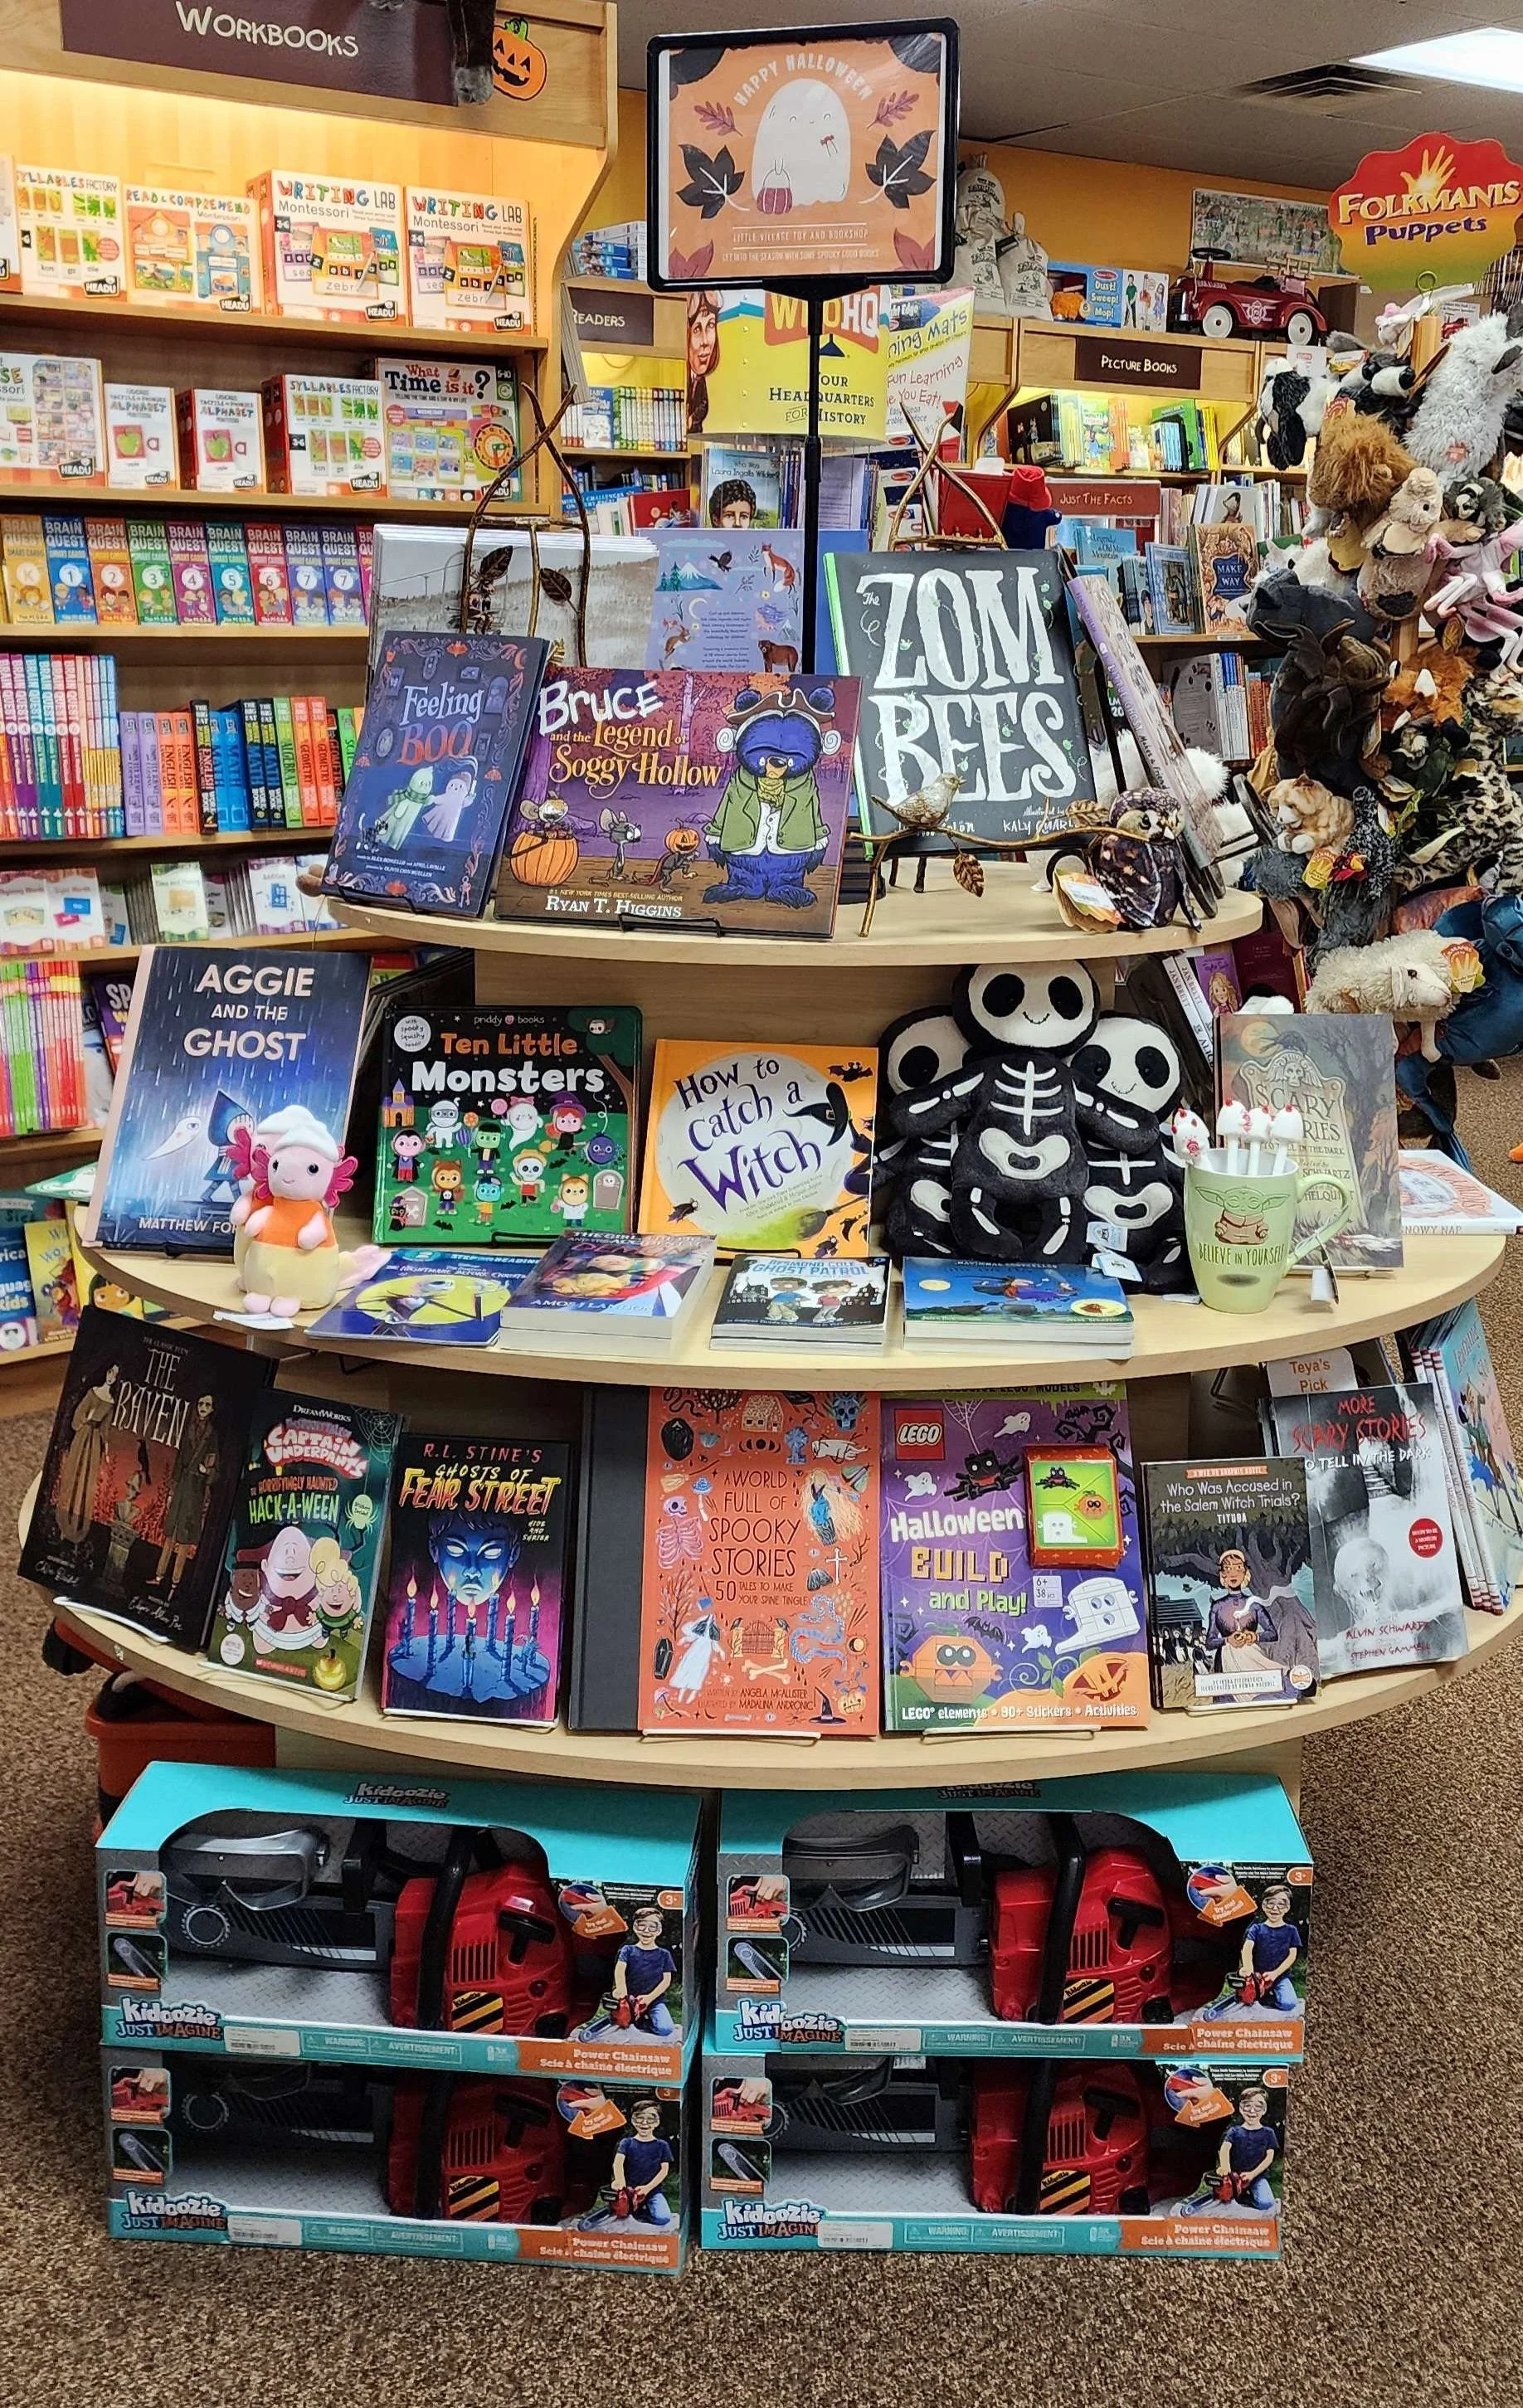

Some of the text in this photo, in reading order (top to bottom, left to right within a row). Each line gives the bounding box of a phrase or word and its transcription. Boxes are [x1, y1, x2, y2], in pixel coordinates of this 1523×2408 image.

[175, 1, 359, 58] WORKBOOKS
[733, 52, 873, 106] HAPPY HALLOWEEN
[126, 189, 158, 204] READ
[277, 180, 396, 210] WRITING LAB
[1338, 180, 1521, 225] FOLKMANIS
[279, 199, 350, 219] Montessori
[732, 228, 869, 243] LITTLE VILLAGE TOY AND BOOKSHOP
[1095, 280, 1117, 291] Dust!
[1091, 292, 1119, 306] Sweep!
[771, 293, 839, 330] WO
[1094, 307, 1115, 322] Mop!
[927, 309, 968, 342] Mats
[405, 364, 440, 378] What
[910, 355, 964, 387] Learning
[1101, 354, 1178, 375] PICTURE BOOKS
[290, 380, 379, 396] SYLLABLES FACTORY
[384, 370, 442, 393] Time
[445, 381, 460, 394] is
[819, 372, 849, 387] OUR
[898, 387, 942, 410] You Eat!
[785, 407, 808, 422] FOR
[352, 477, 379, 490] HEADU
[1059, 492, 1134, 506] JUST THE FACTS
[129, 524, 167, 538] BRAIN
[286, 529, 319, 542] BRAIN
[130, 537, 169, 551] QUEST
[286, 542, 322, 556] QUEST
[1217, 564, 1243, 575] MAKE
[1221, 576, 1241, 587] WAY
[862, 591, 880, 607] The
[855, 566, 1065, 691] ZOM
[400, 681, 485, 727] Feeling
[397, 719, 474, 766] BOO
[550, 709, 689, 759] and the Legend of
[869, 691, 1078, 808] BEES
[548, 743, 723, 800] Soggy Hollow
[560, 889, 574, 898] NEW
[576, 889, 592, 898] YORK
[594, 890, 611, 898] TIMES
[657, 893, 684, 903] AUTHOR
[545, 896, 683, 918] RYAN T. HIGGINS
[196, 963, 315, 998] AGGIE
[212, 1004, 289, 1022] AND THE
[474, 1015, 545, 1027] priddy books
[183, 1027, 307, 1062] GHOST
[440, 1032, 578, 1057] Ten Little
[411, 1060, 605, 1095] Monsters
[673, 1058, 781, 1112] How to
[786, 1081, 804, 1105] a
[1255, 1083, 1336, 1121] SCARY
[677, 1129, 822, 1216] Witch
[139, 1216, 208, 1233] MATTHEW
[1439, 1225, 1462, 1235] NAP
[1199, 1242, 1287, 1267] BELIEVE IN YOURSELF
[752, 1262, 869, 1277] GHOST PATROL
[144, 1347, 181, 1392] THE
[1289, 1358, 1331, 1376] Teya's
[1300, 1379, 1329, 1394] Pick
[111, 1379, 192, 1451] RAVEN
[293, 1404, 353, 1423] DREAMWORKS
[1337, 1394, 1376, 1416] MORE
[898, 1424, 942, 1445] LEGO
[1291, 1412, 1427, 1453] SCARY STORIES
[265, 1445, 370, 1478] UNDERPANTS
[423, 1442, 543, 1465] R.L. STINE'S
[1318, 1456, 1350, 1472] TELL
[1399, 1447, 1432, 1462] DARK
[307, 1475, 339, 1491] HAUNTED
[435, 1462, 534, 1486] GHOSTS OF
[732, 1470, 788, 1490] WORLD
[398, 1467, 562, 1517] FEAR STREET
[1166, 1477, 1293, 1497] Who Was Accused in
[249, 1492, 340, 1525] HACK-A-WEEN
[723, 1491, 788, 1514] FULL OF
[1160, 1492, 1301, 1514] the Salem Witch Trials?
[889, 1506, 1025, 1544] Halloween
[1216, 1513, 1248, 1525] TITUBA
[708, 1517, 802, 1546] SPOOKY
[711, 1547, 797, 1578] STORIES
[911, 1545, 1009, 1584] BUILD
[715, 1579, 737, 1602] 50
[738, 1581, 795, 1593] TALES TO MAKE
[1036, 1578, 1048, 1586] 6+
[737, 1594, 809, 1607] YOUR SPINE TINGLE
[928, 1588, 1029, 1618] and Play!
[1036, 1588, 1047, 1598] 38
[1345, 1627, 1375, 1641] ALVIN
[1350, 1647, 1387, 1661] STEPHEN
[740, 1686, 768, 1699] ANGELA
[937, 1703, 1139, 1720] elements 90+ Stickers Activities
[122, 1997, 217, 2026] Kidoozie
[741, 2000, 838, 2031] Kidoozie
[116, 2021, 223, 2040] JUST IMAGINE
[1197, 2027, 1292, 2039] Power Chainsaw
[1236, 2039, 1293, 2051] électrique
[540, 2058, 564, 2069] Scie
[613, 2061, 673, 2076] électrique
[724, 2201, 821, 2226] Kidoozie
[1175, 2225, 1270, 2237] Power Chainsaw
